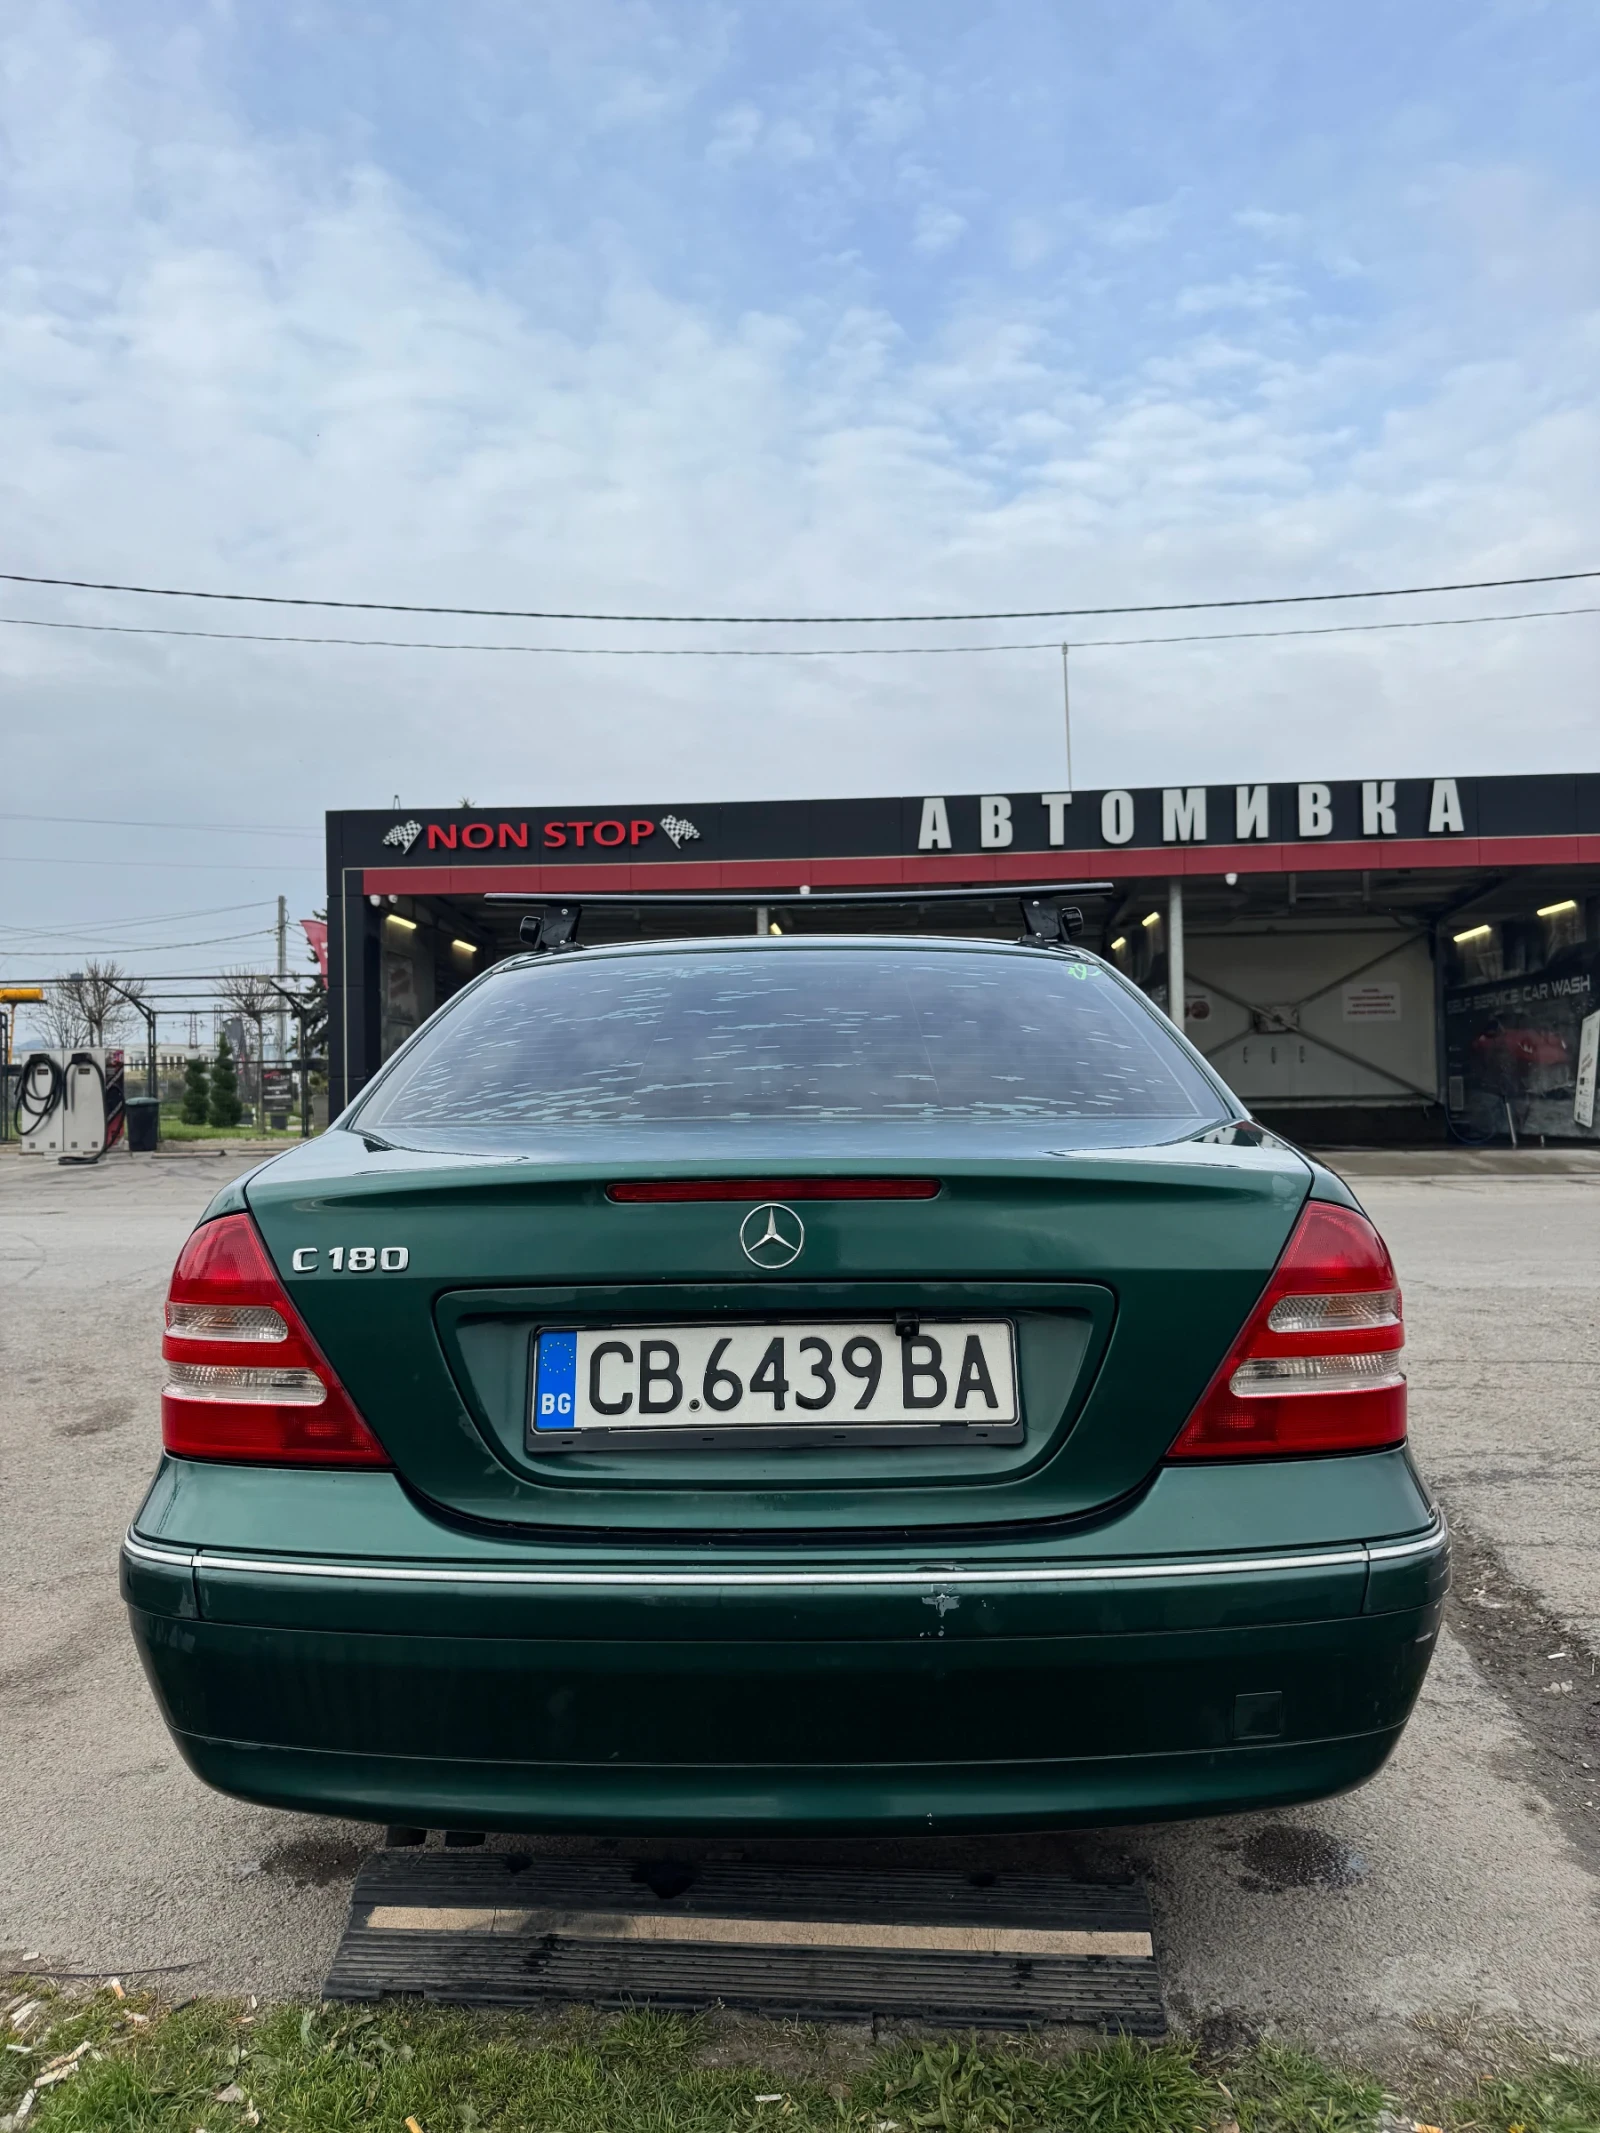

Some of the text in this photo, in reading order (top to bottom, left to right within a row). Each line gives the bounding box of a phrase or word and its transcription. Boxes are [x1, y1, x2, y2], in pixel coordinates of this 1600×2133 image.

[918, 779, 1464, 850] АВТОМИВКА
[427, 820, 655, 850] NON STOP
[1473, 988, 1519, 1010] SERVICE
[1522, 983, 1549, 1002] CAR
[1551, 974, 1591, 998] WASH
[292, 1246, 409, 1271] C 180
[541, 1393, 572, 1415] BG
